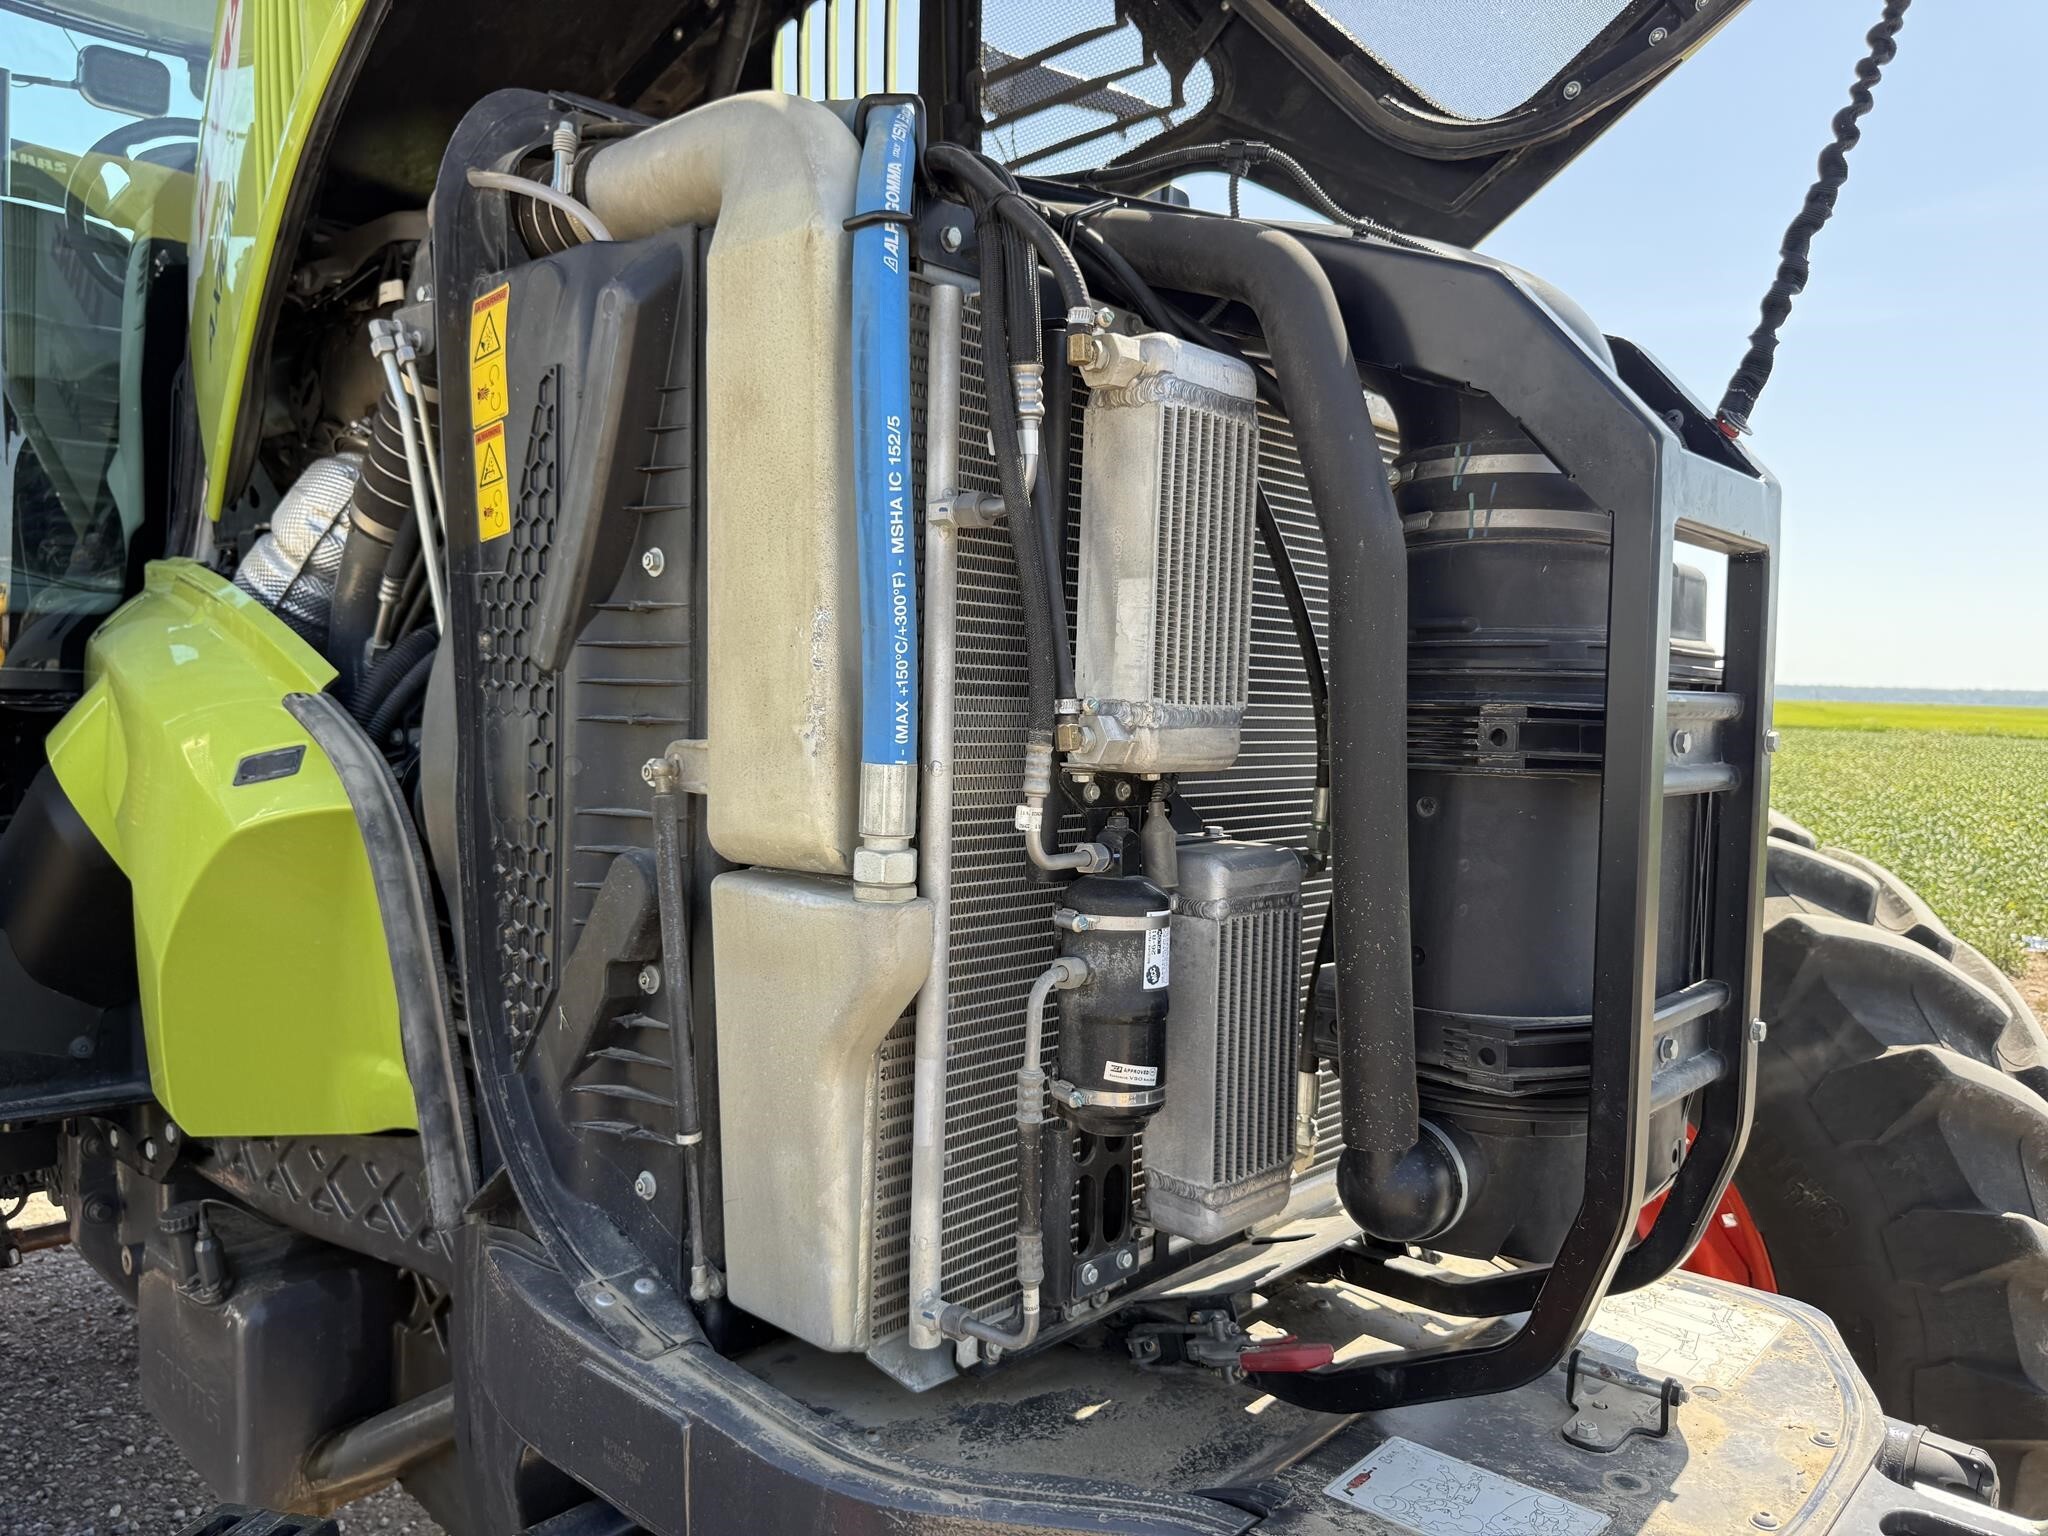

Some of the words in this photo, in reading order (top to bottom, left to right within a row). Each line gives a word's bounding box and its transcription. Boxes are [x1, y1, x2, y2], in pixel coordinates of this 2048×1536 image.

[11, 150, 67, 173] LAAS
[883, 162, 902, 258] ALFGOMMA
[886, 415, 901, 465] 152/5
[888, 471, 902, 491] IC
[889, 499, 905, 554] MSHA
[894, 701, 909, 744] (MAX
